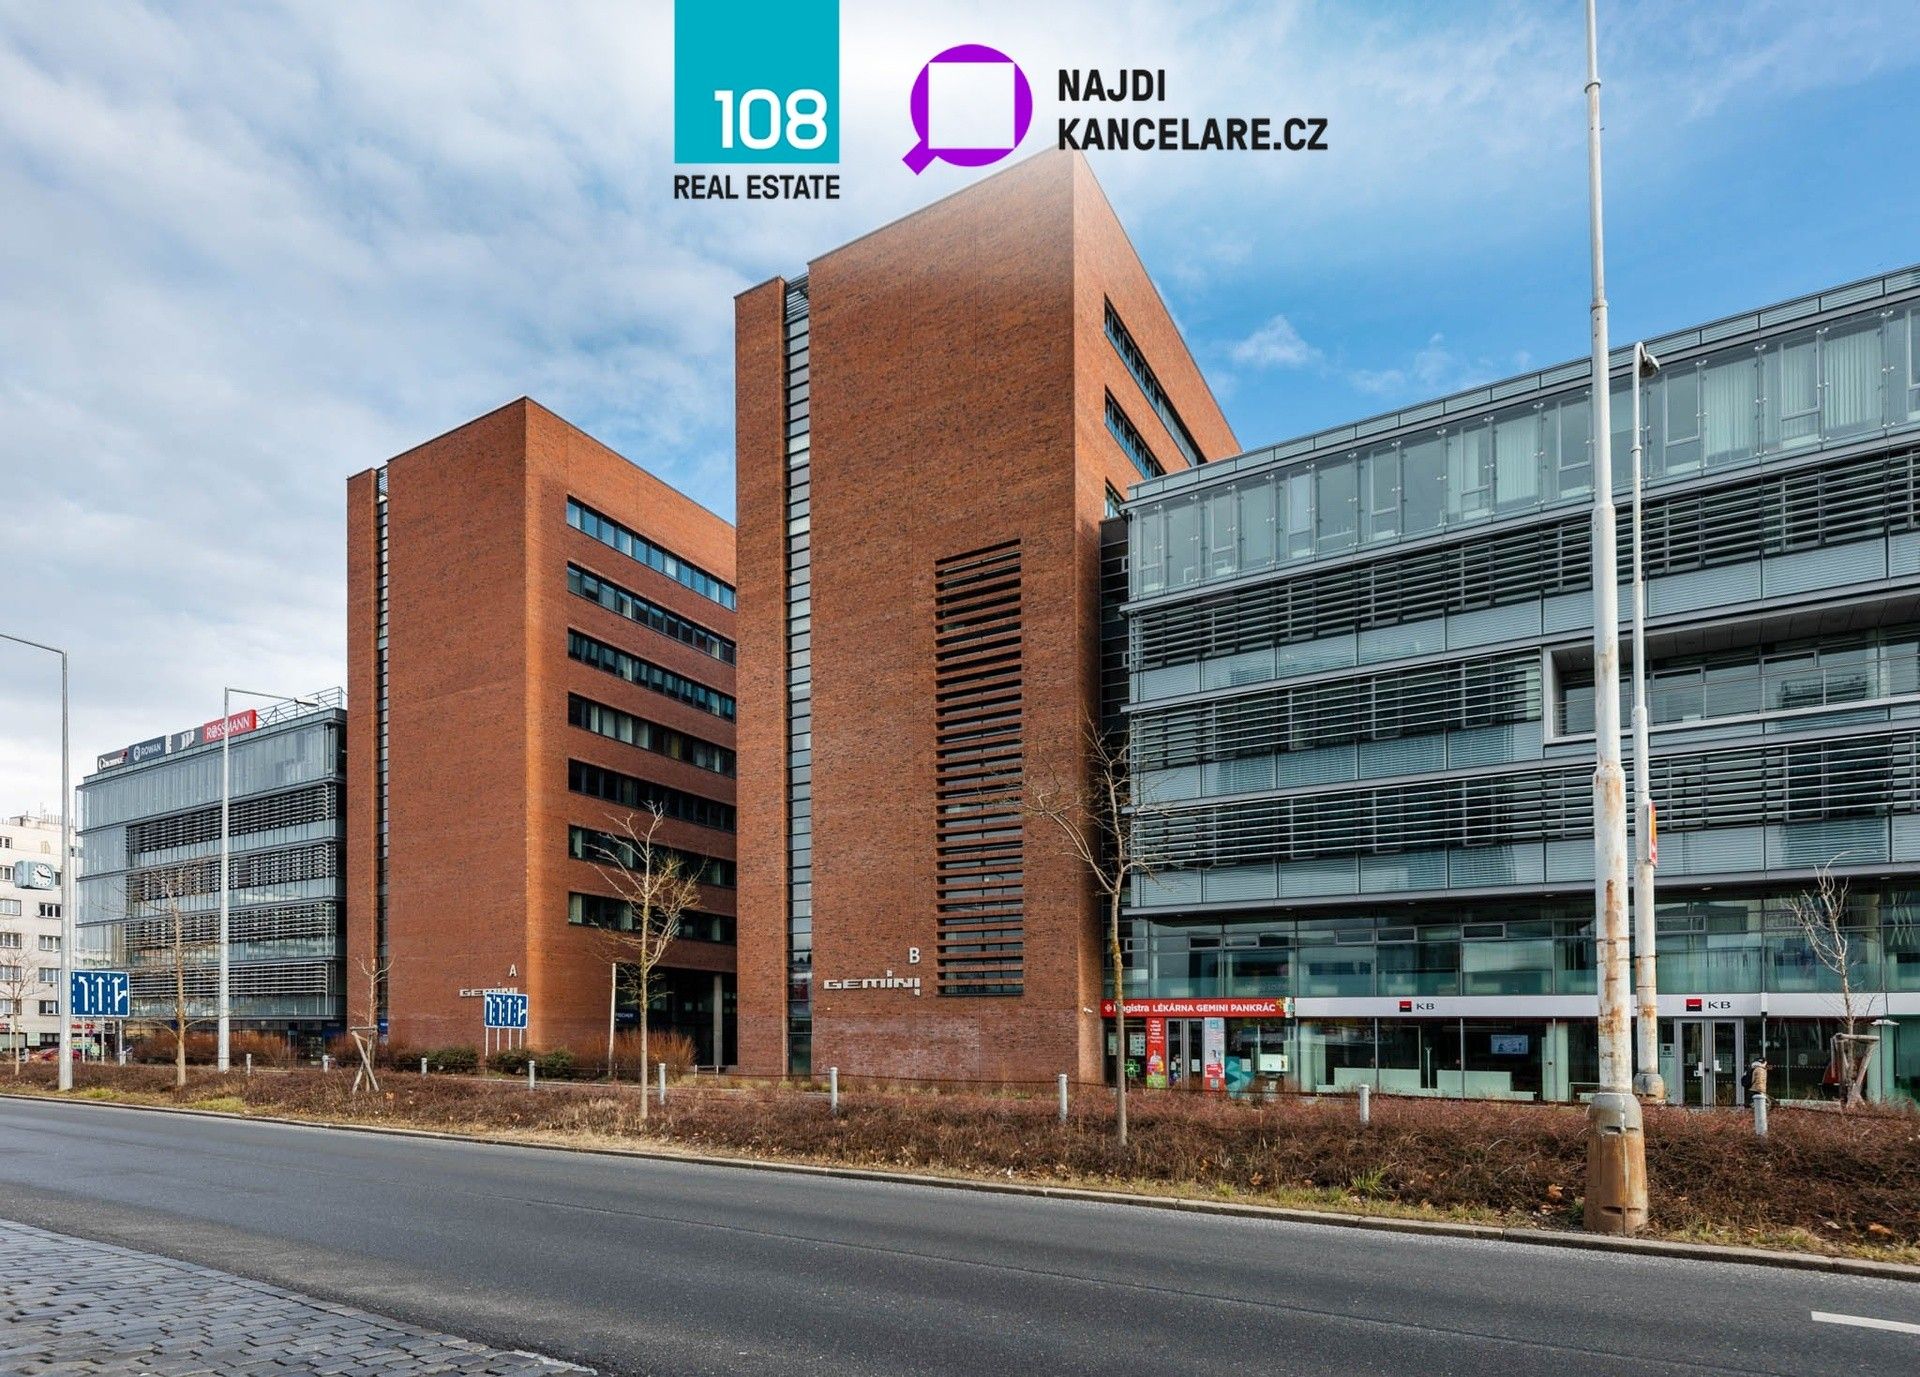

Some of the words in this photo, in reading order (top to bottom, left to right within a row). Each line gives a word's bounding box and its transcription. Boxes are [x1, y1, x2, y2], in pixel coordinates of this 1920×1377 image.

[140, 743, 162, 755] ROWAN
[909, 947, 920, 963] B
[509, 963, 517, 977] A
[823, 970, 921, 996] GEMINI
[1152, 1003, 1194, 1012] LÉKÁRNA
[1196, 1003, 1228, 1012] GEMINI
[1230, 1002, 1276, 1012] PANKRÁC
[1708, 1001, 1731, 1009] KB
